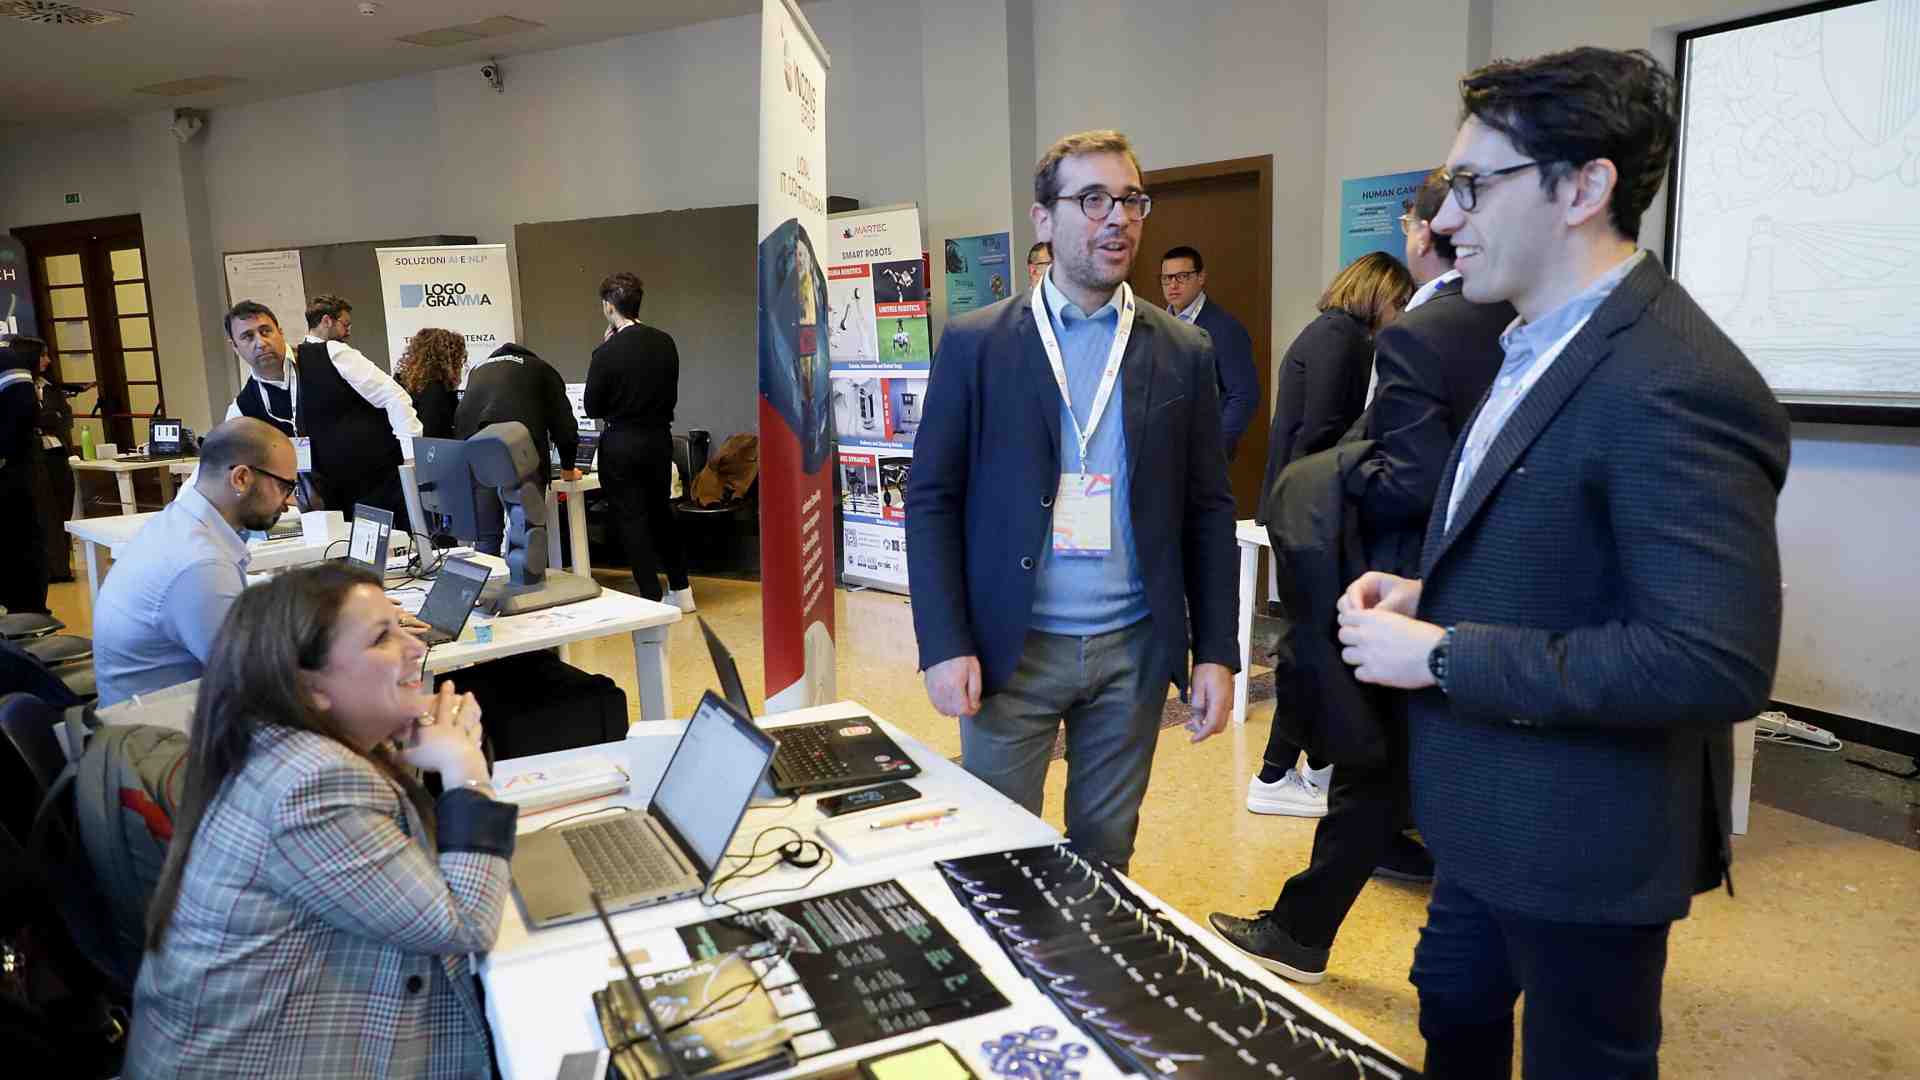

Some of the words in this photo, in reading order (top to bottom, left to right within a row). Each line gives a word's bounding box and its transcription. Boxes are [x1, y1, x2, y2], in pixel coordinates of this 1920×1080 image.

[1362, 189, 1394, 201] HUMAN
[842, 248, 864, 260] SMART
[865, 247, 893, 257] ROBOTS
[395, 256, 446, 266] SOLUZIONI
[424, 282, 466, 296] LOGO
[426, 293, 492, 307] GRAMMA
[464, 333, 496, 342] TENZA
